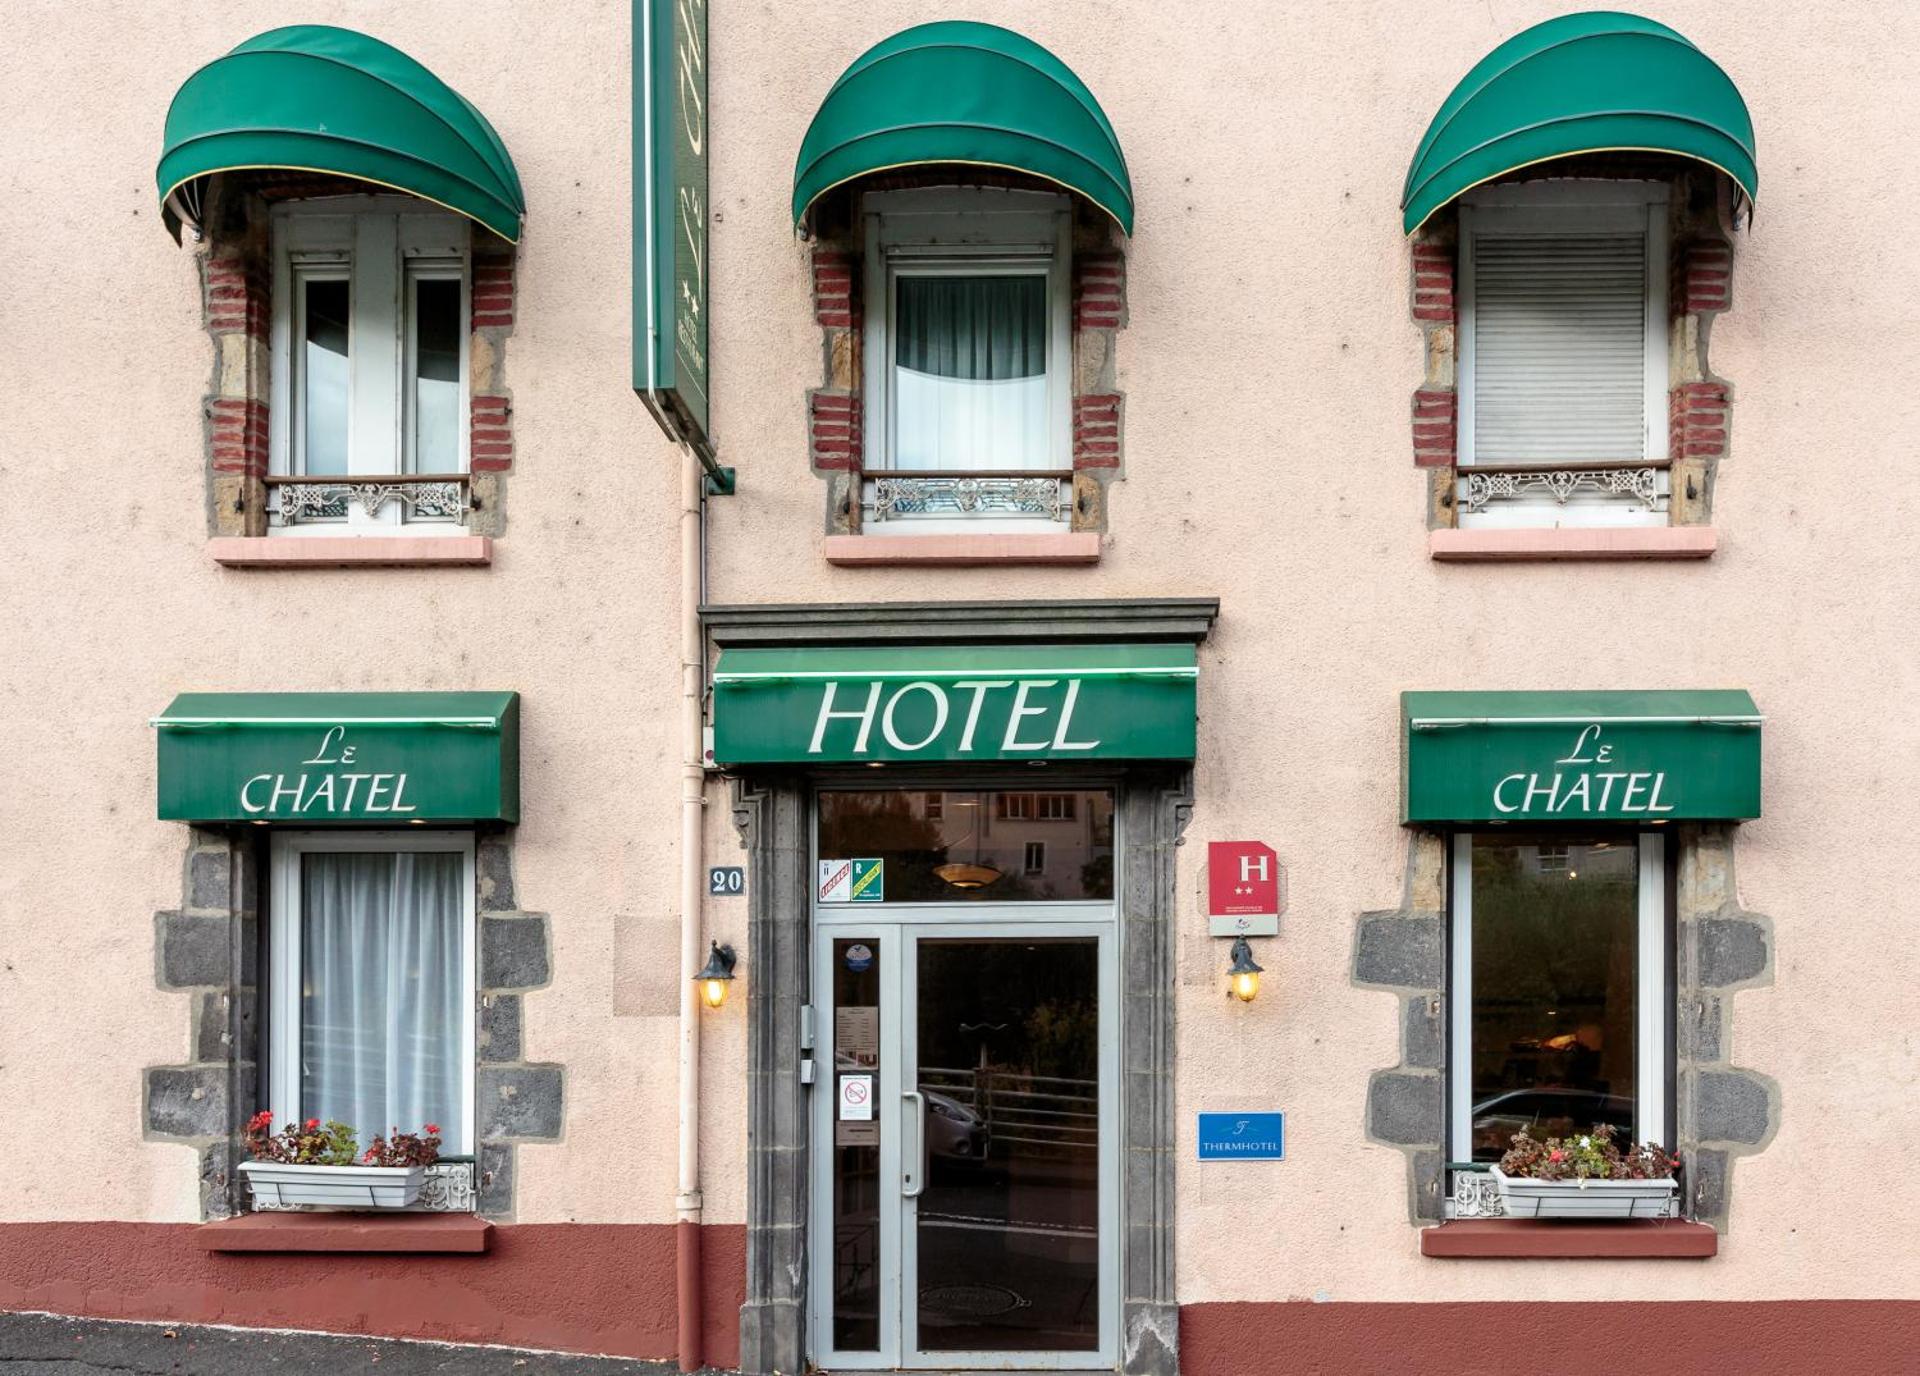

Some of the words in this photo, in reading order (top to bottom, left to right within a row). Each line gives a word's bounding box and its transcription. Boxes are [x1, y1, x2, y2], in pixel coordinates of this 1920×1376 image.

[808, 678, 1100, 753] HOTEL
[240, 774, 417, 813] CHATEL
[1493, 772, 1675, 813] CHATEL
[712, 871, 742, 892] 20
[1241, 855, 1268, 882] H
[1203, 1142, 1279, 1152] THERMHOTEL
